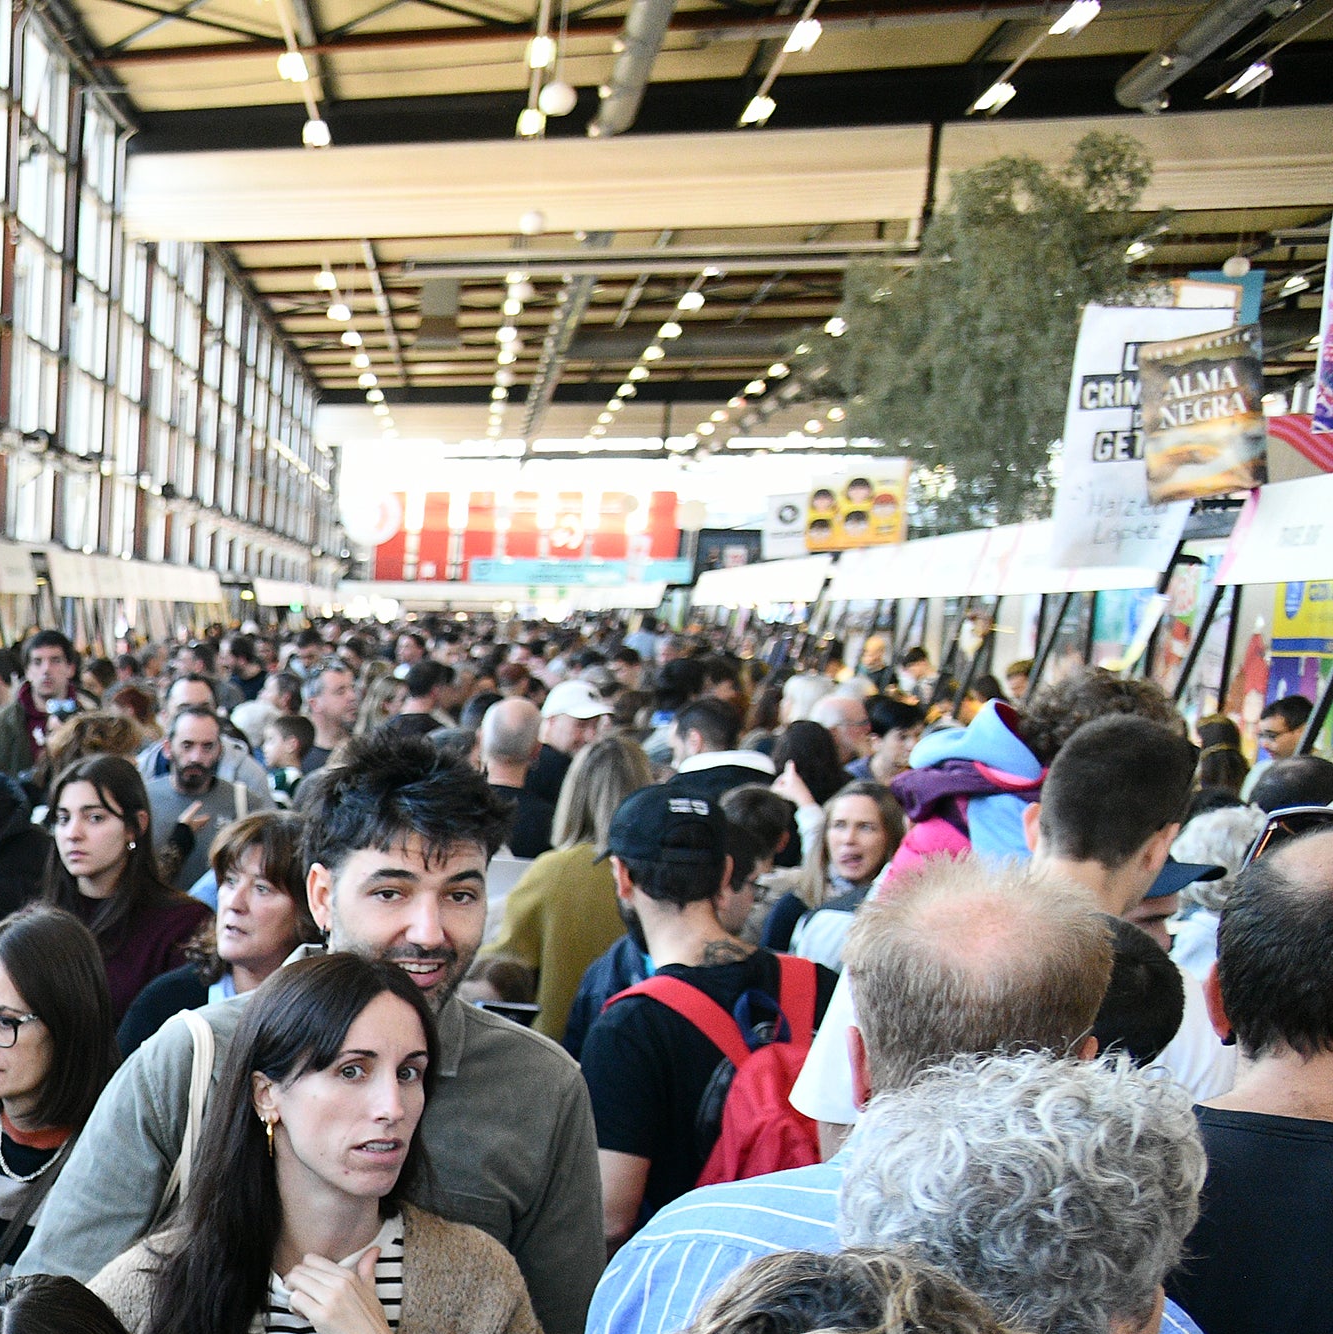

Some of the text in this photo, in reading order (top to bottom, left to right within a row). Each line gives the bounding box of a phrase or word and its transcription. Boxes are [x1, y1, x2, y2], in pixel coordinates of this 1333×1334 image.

[1083, 374, 1142, 409] CRÍM
[1163, 365, 1238, 400] ALMA
[1157, 391, 1247, 429] NEGRA
